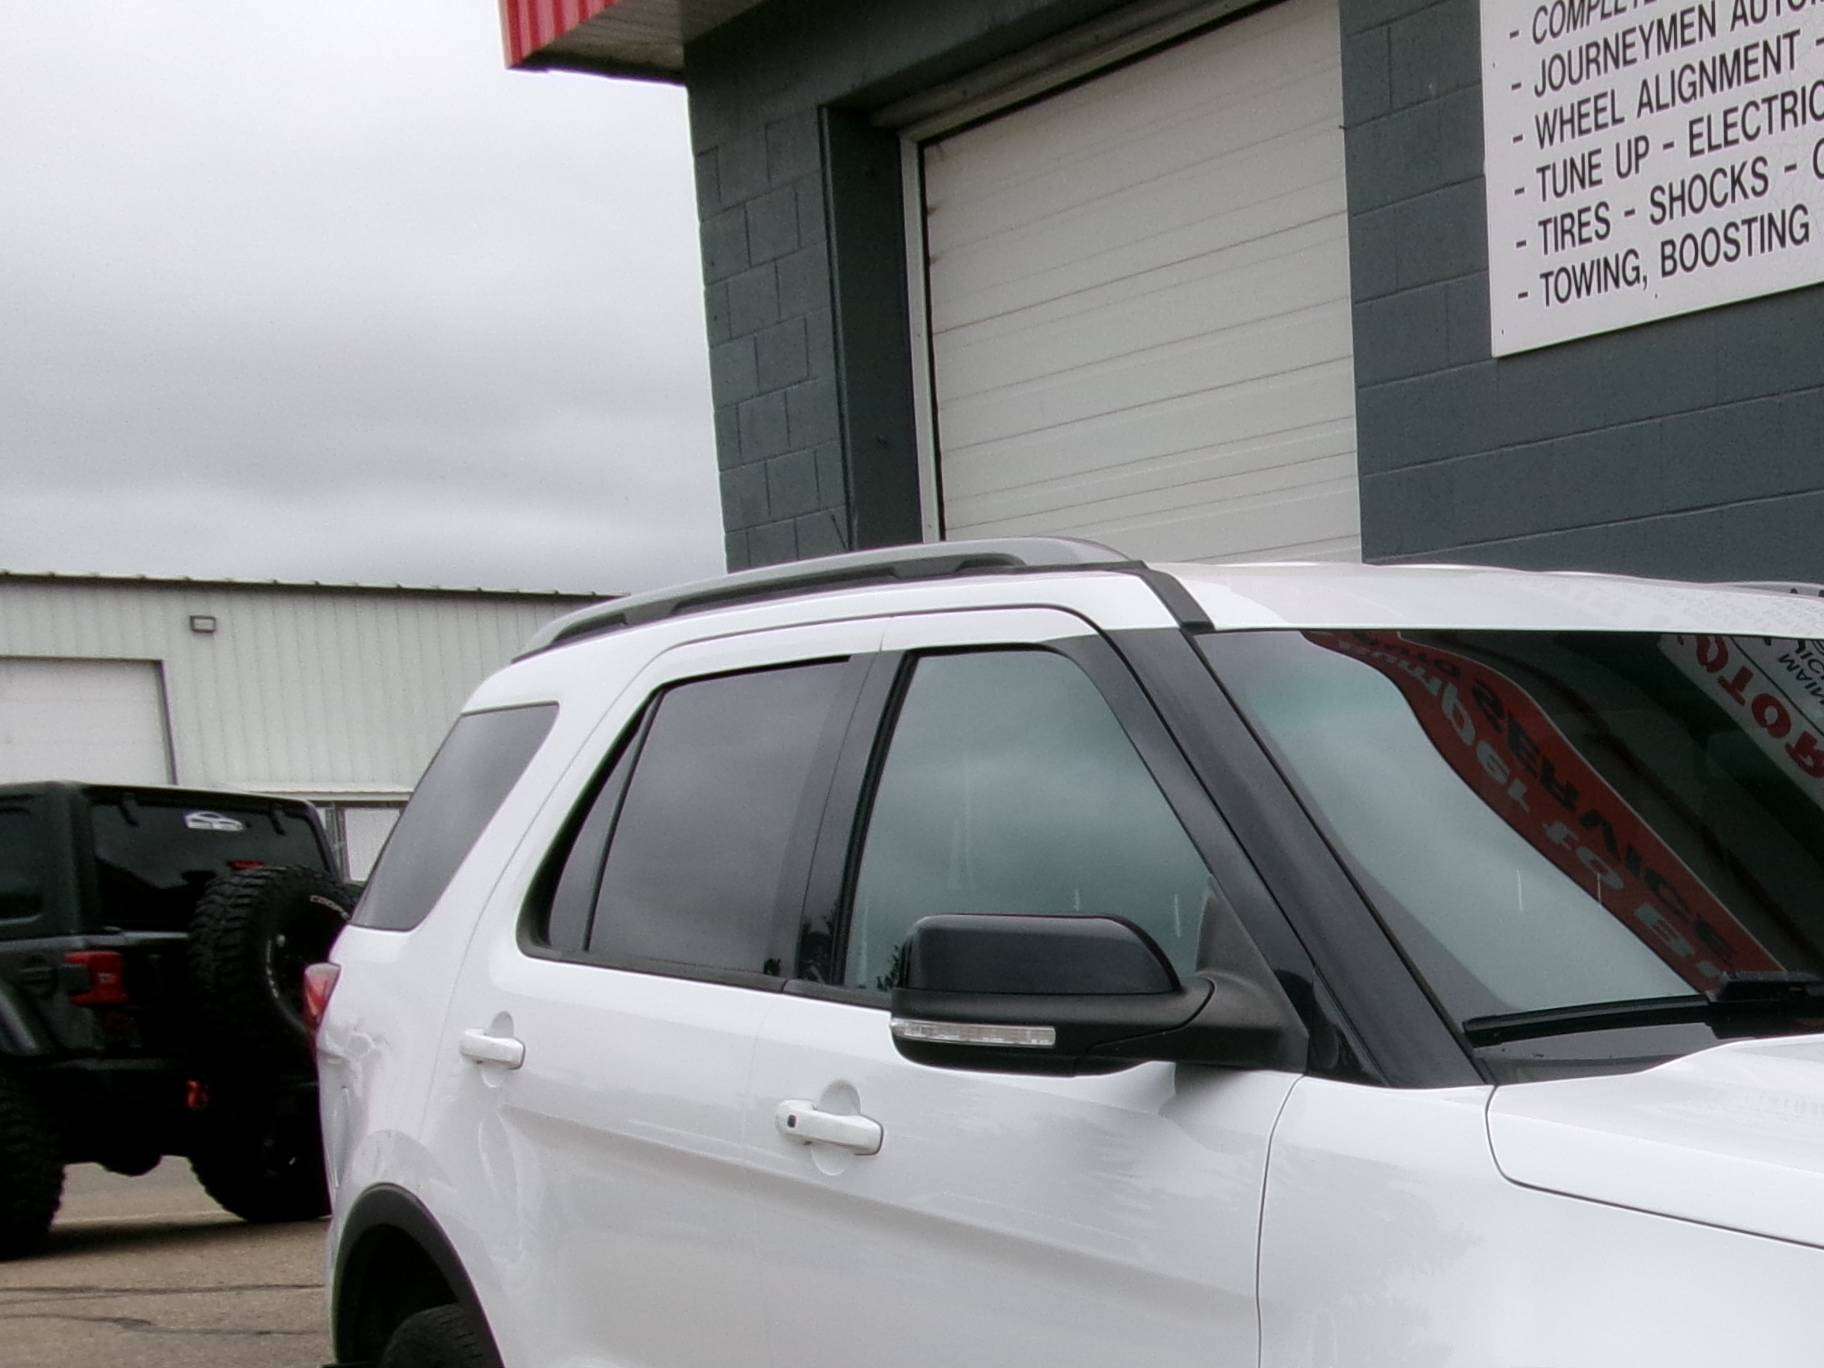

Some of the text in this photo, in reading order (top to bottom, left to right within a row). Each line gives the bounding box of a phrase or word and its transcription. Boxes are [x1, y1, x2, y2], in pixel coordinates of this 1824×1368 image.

[1532, 0, 1657, 45] COMPL
[1534, 4, 1717, 97] JOURNEYMEN
[1535, 88, 1625, 149] WHEEL
[1637, 29, 1801, 118] ALIGNMENT
[1536, 148, 1603, 202] TUNE
[1615, 135, 1649, 179] UP
[1538, 201, 1611, 255] TIRES
[1650, 156, 1769, 226] SHOCKS
[1540, 248, 1648, 307] TOWING,
[1661, 204, 1810, 278] BOOSTING
